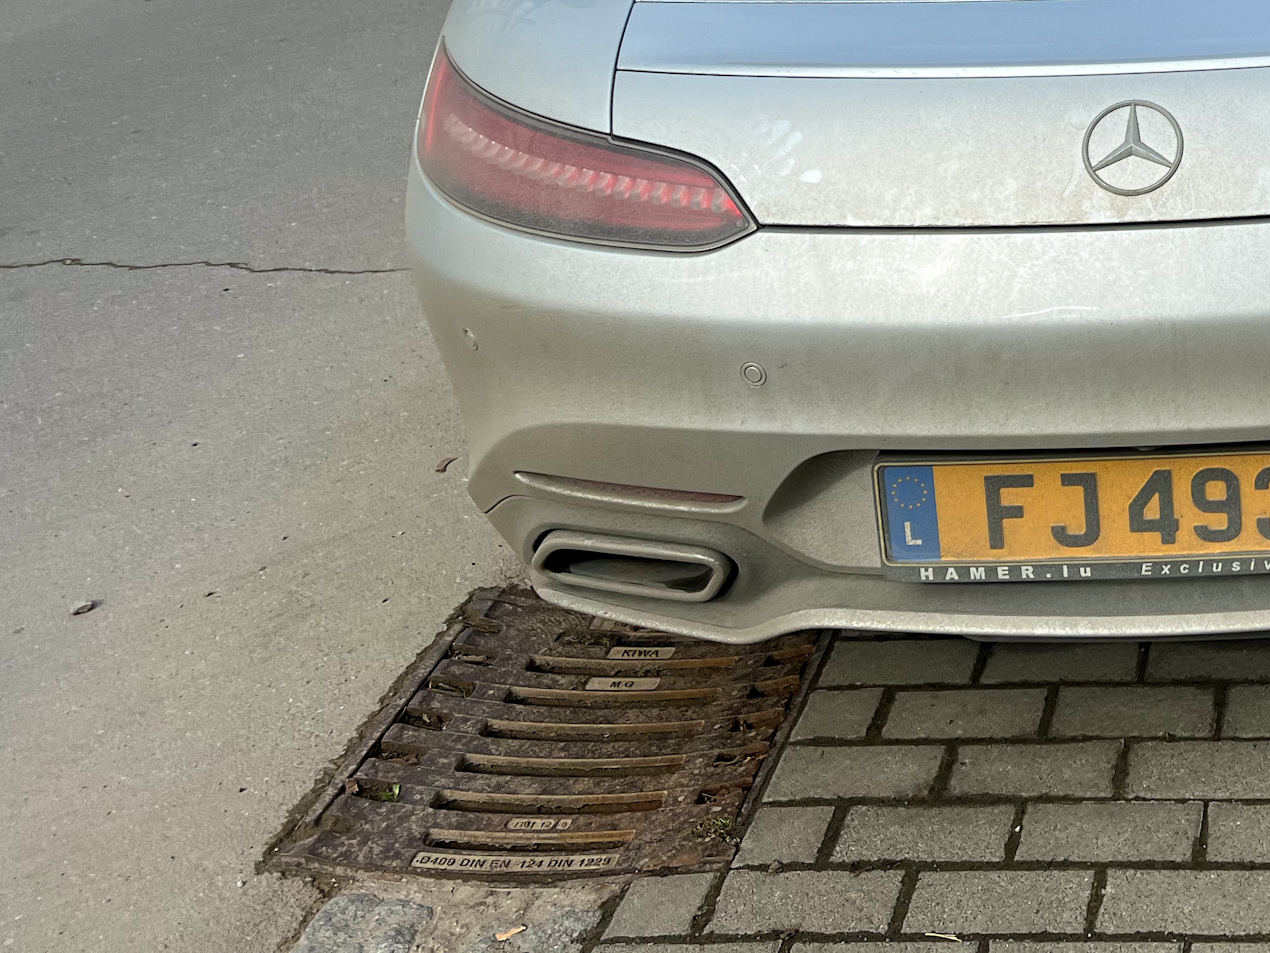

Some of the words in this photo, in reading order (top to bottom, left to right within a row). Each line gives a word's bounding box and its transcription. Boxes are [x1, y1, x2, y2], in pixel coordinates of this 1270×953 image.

[904, 521, 922, 546] L
[621, 649, 659, 658] KIWA
[459, 857, 487, 868] DIN
[488, 859, 511, 868] EN
[547, 859, 575, 868] DIN
